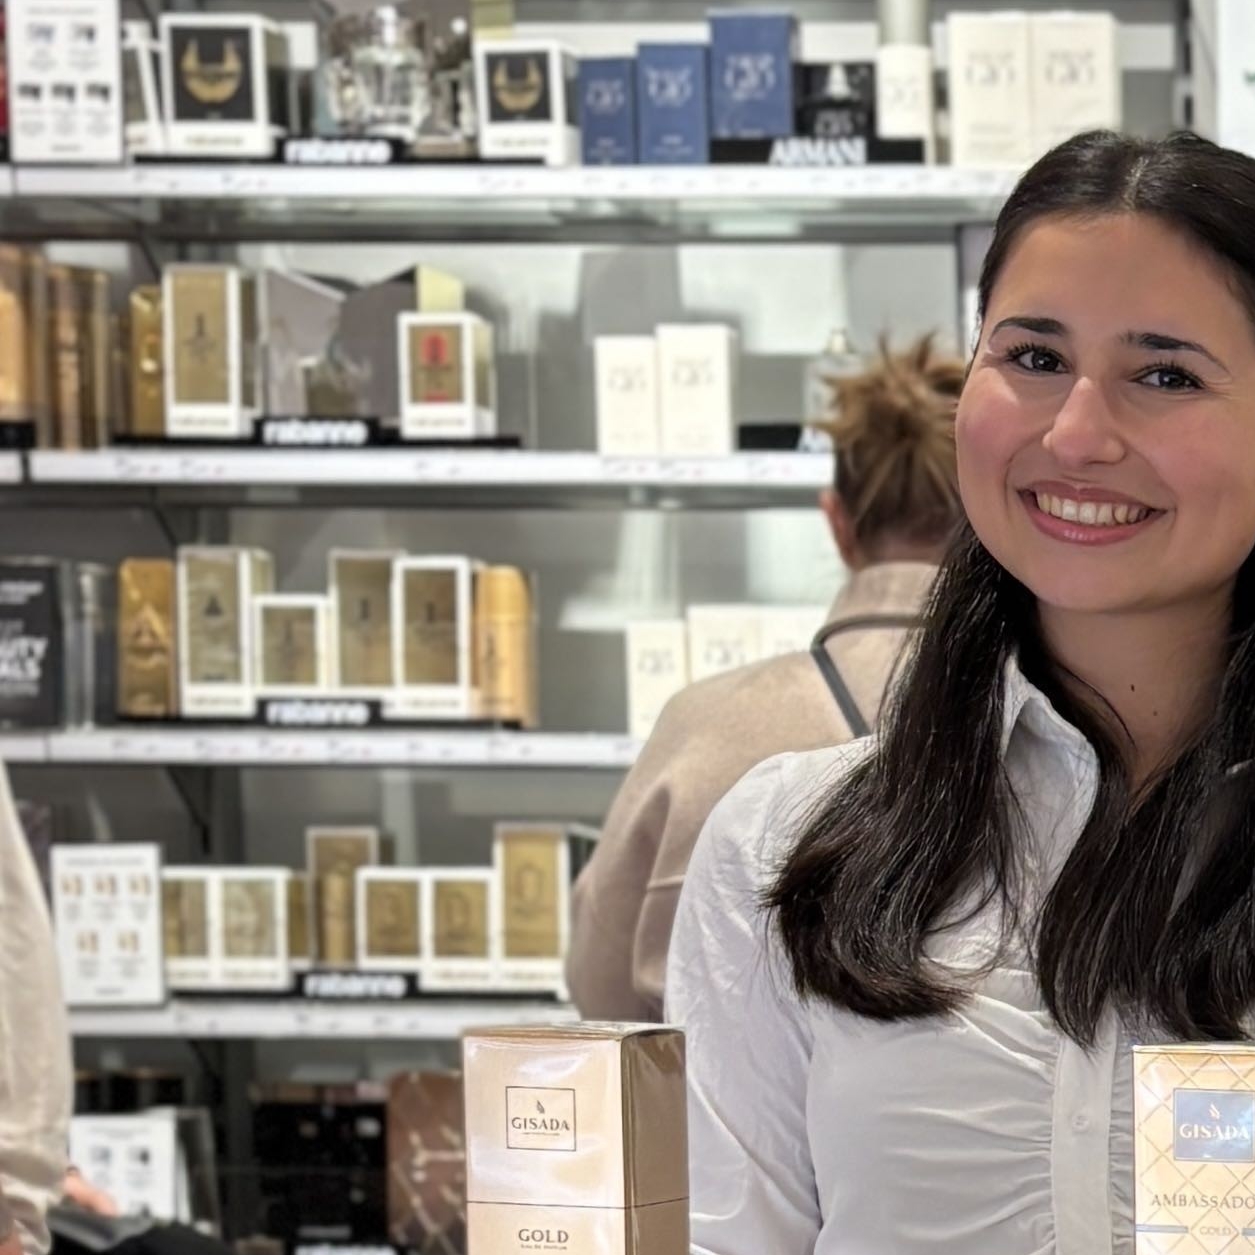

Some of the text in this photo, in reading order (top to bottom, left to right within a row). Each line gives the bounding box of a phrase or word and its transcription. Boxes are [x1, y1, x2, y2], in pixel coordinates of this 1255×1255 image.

[511, 1116, 570, 1132] GISADA
[1179, 1123, 1250, 1141] GISADA
[518, 1228, 569, 1243] GOLD
[1199, 1226, 1232, 1236] GOLD
